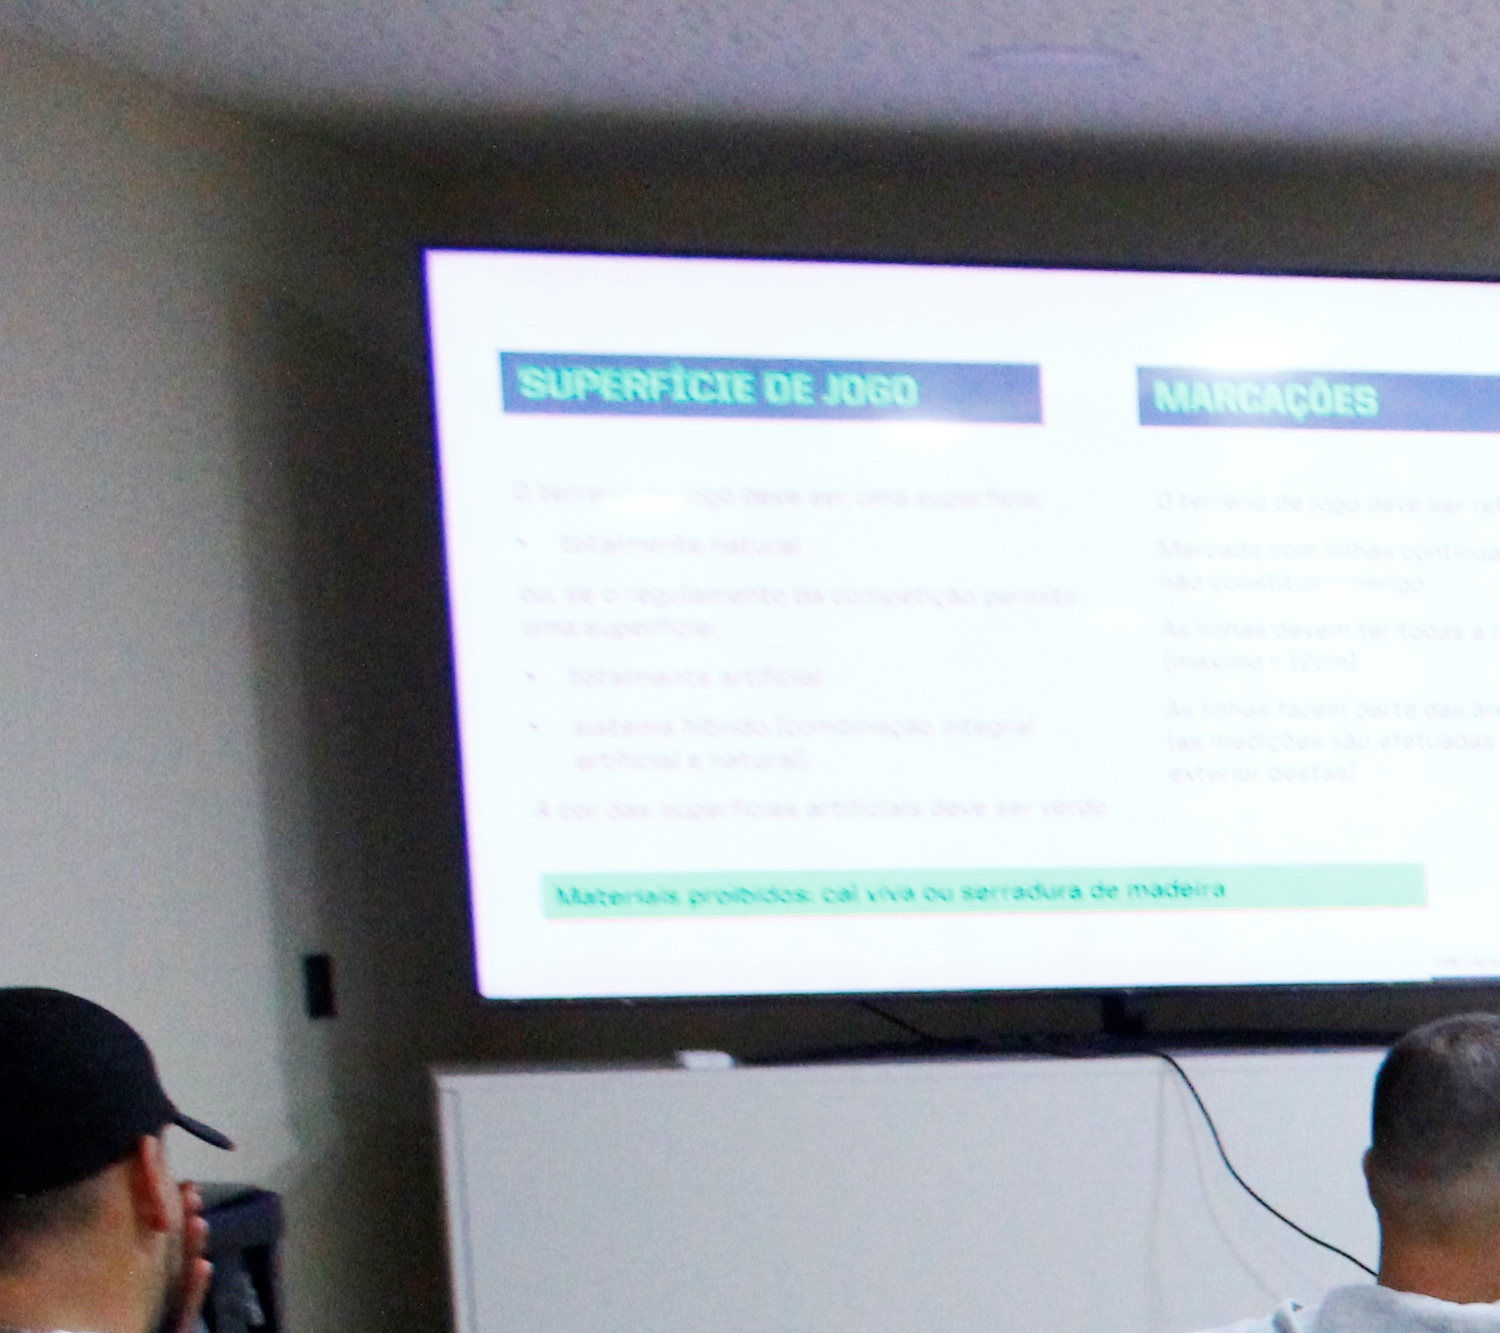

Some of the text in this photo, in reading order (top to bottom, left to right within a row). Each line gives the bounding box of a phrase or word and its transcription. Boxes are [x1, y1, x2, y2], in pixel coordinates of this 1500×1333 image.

[517, 362, 920, 409] SUPERFÍCIE DE JOGO
[1153, 376, 1381, 421] MARCAÇÕES
[510, 478, 534, 505] O
[741, 485, 803, 508] deve
[808, 486, 850, 508] ser
[855, 488, 912, 509] uma
[1179, 491, 1269, 514] terreno
[1275, 493, 1305, 513] de
[1308, 492, 1361, 518] jogo
[1366, 494, 1422, 515] deve
[1428, 496, 1461, 515] ser
[559, 531, 804, 558] totalmente natural
[1158, 537, 1263, 561] Marcado
[563, 584, 598, 607] se
[601, 586, 622, 606] o
[623, 583, 789, 611] regulamento
[793, 585, 828, 608] da
[831, 586, 979, 612] competição
[519, 619, 583, 640] uma
[1272, 620, 1350, 641] devem
[1398, 621, 1465, 641] todas
[567, 664, 826, 690] totalmente artificial
[1354, 702, 1418, 723] parte
[1425, 701, 1466, 720] das
[572, 717, 678, 740] sistema
[942, 715, 1037, 742] integral
[574, 748, 681, 773] artificial
[687, 752, 704, 771] e
[1168, 765, 1259, 785] exterior
[555, 802, 600, 822] cor
[604, 800, 654, 822] das
[805, 796, 924, 822] artificiais
[928, 798, 989, 820] deve
[993, 798, 1034, 819] ser
[555, 882, 682, 907] Materiais
[820, 880, 860, 904] cal
[865, 879, 918, 903] viva
[922, 882, 956, 903] ou
[960, 877, 1083, 902] serradura
[1090, 877, 1121, 900] de
[1126, 875, 1228, 900] madeira
